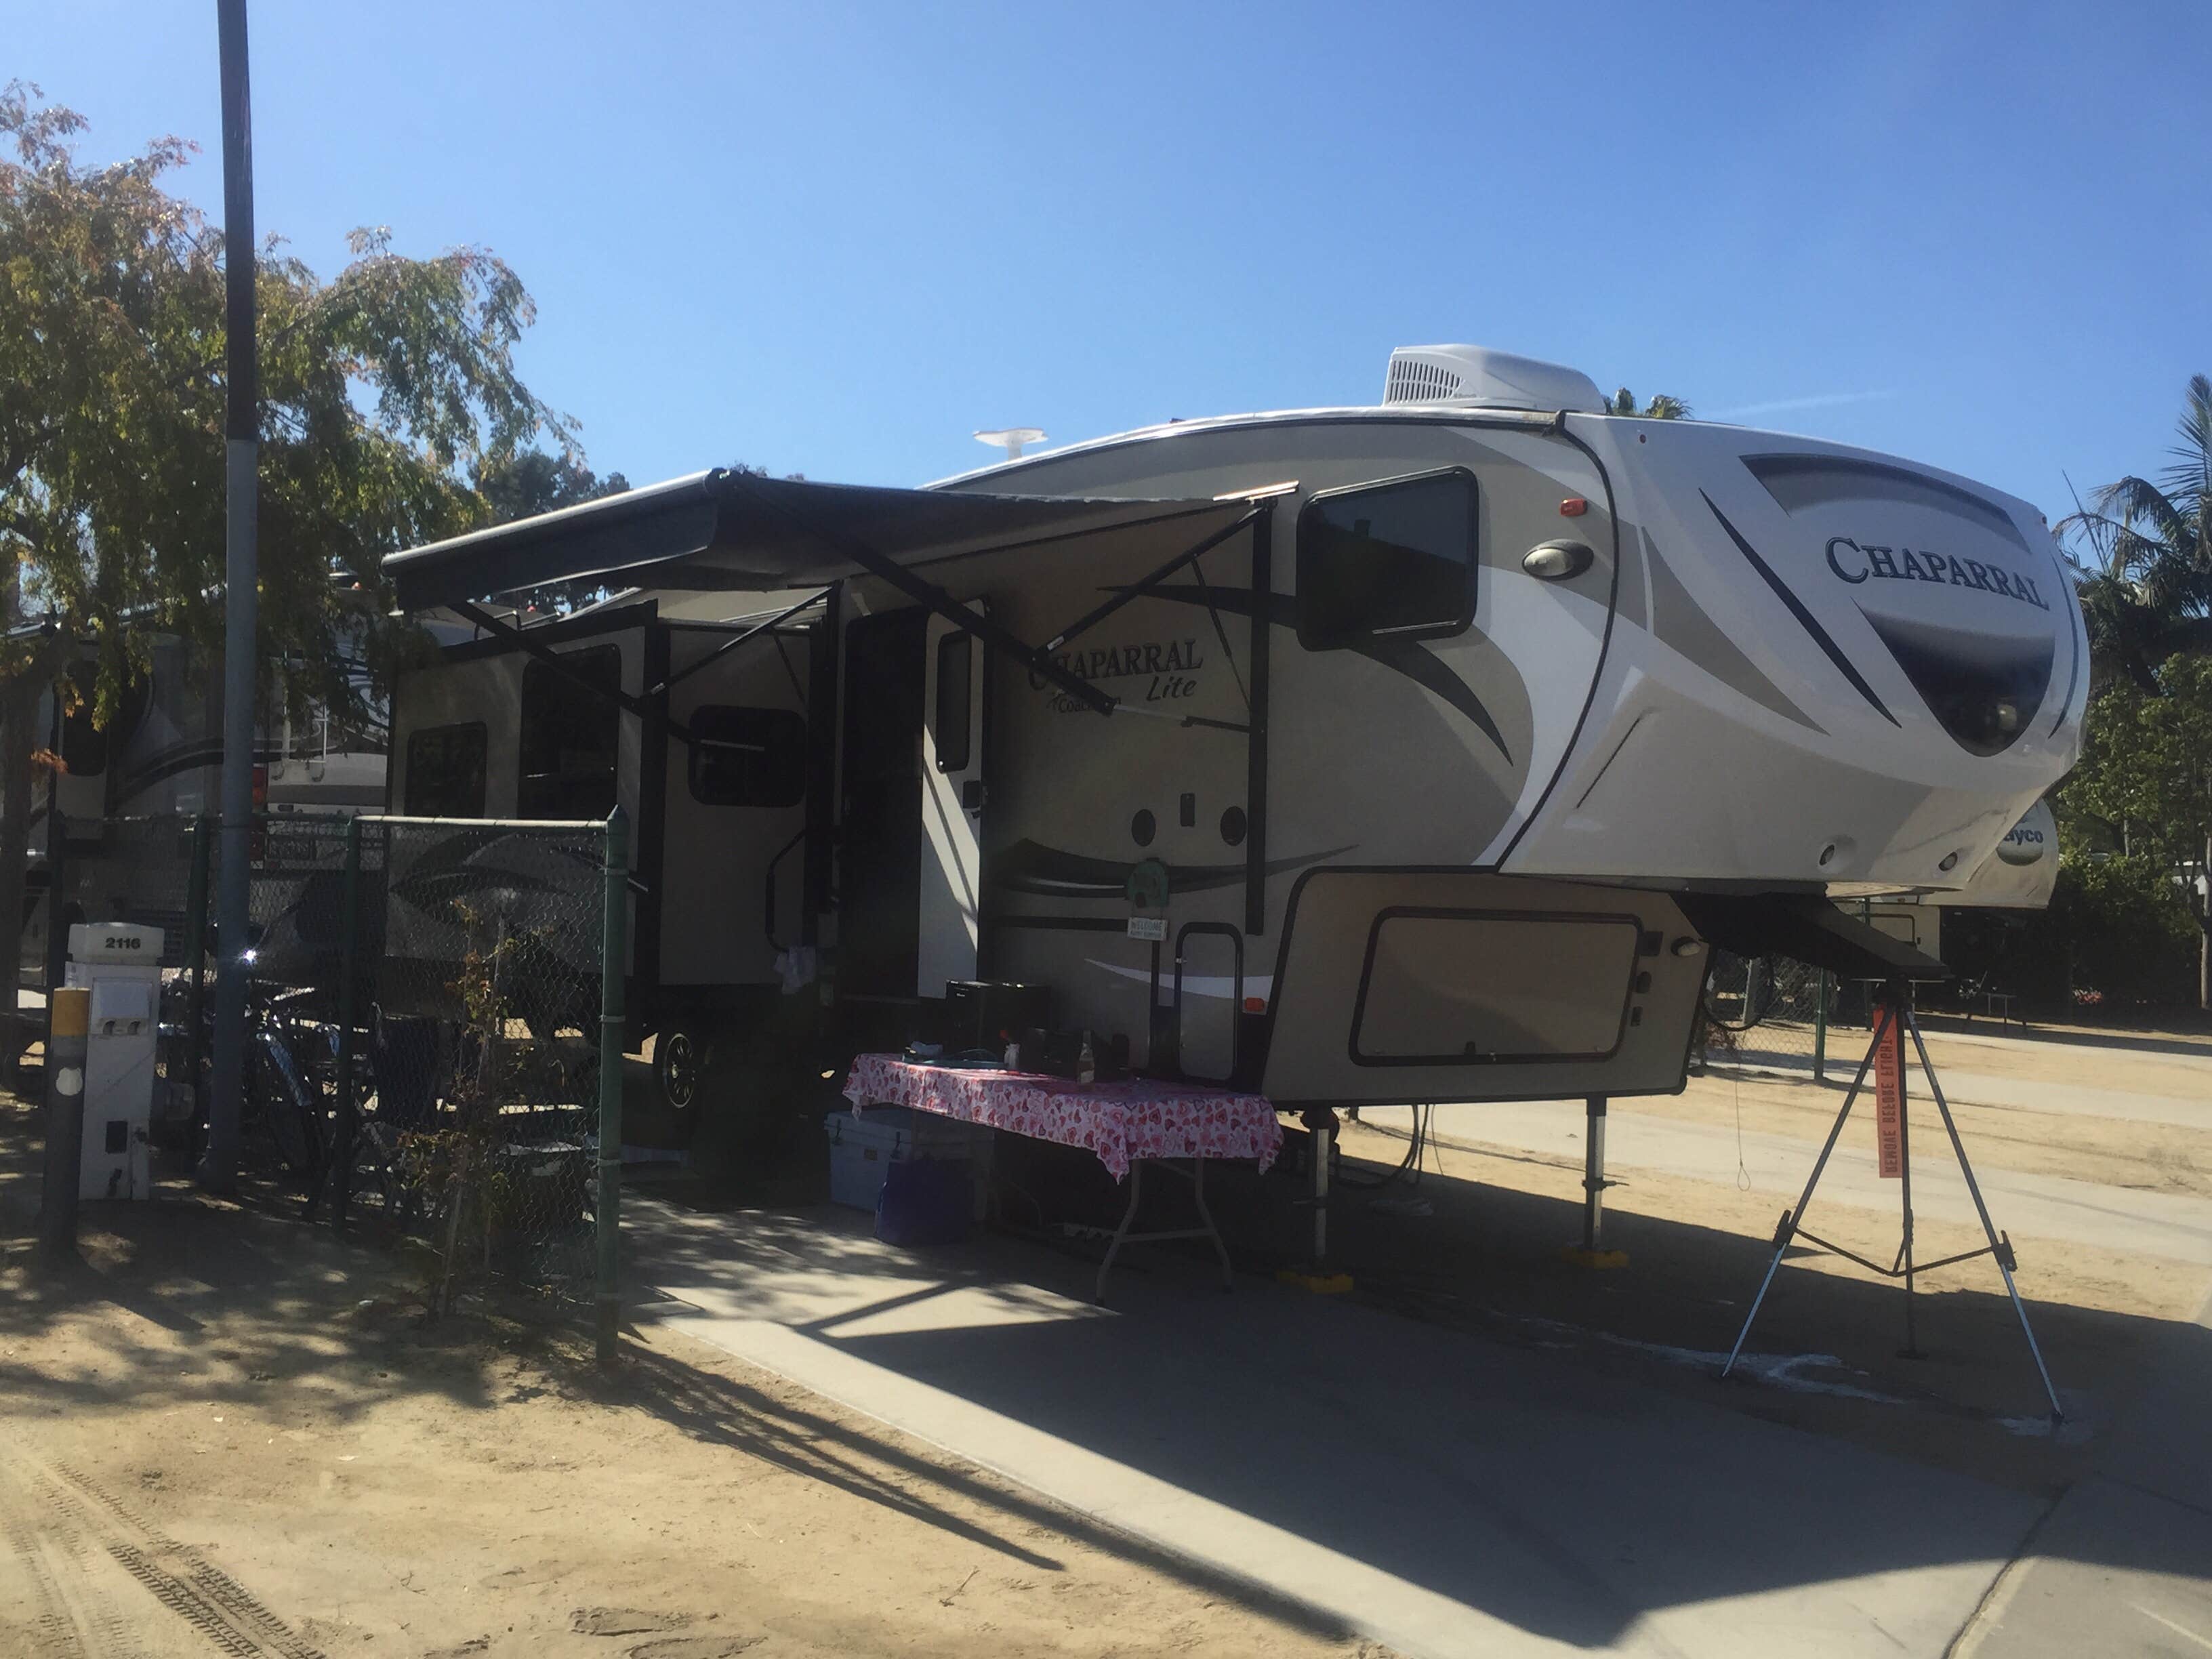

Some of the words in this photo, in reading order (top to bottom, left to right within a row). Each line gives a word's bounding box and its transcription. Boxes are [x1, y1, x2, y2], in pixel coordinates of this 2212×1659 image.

[1825, 536, 2050, 611] CHAPARRAL
[1146, 675, 1197, 701] Lite
[2003, 829, 2044, 846] ayco
[105, 937, 141, 949] 2116
